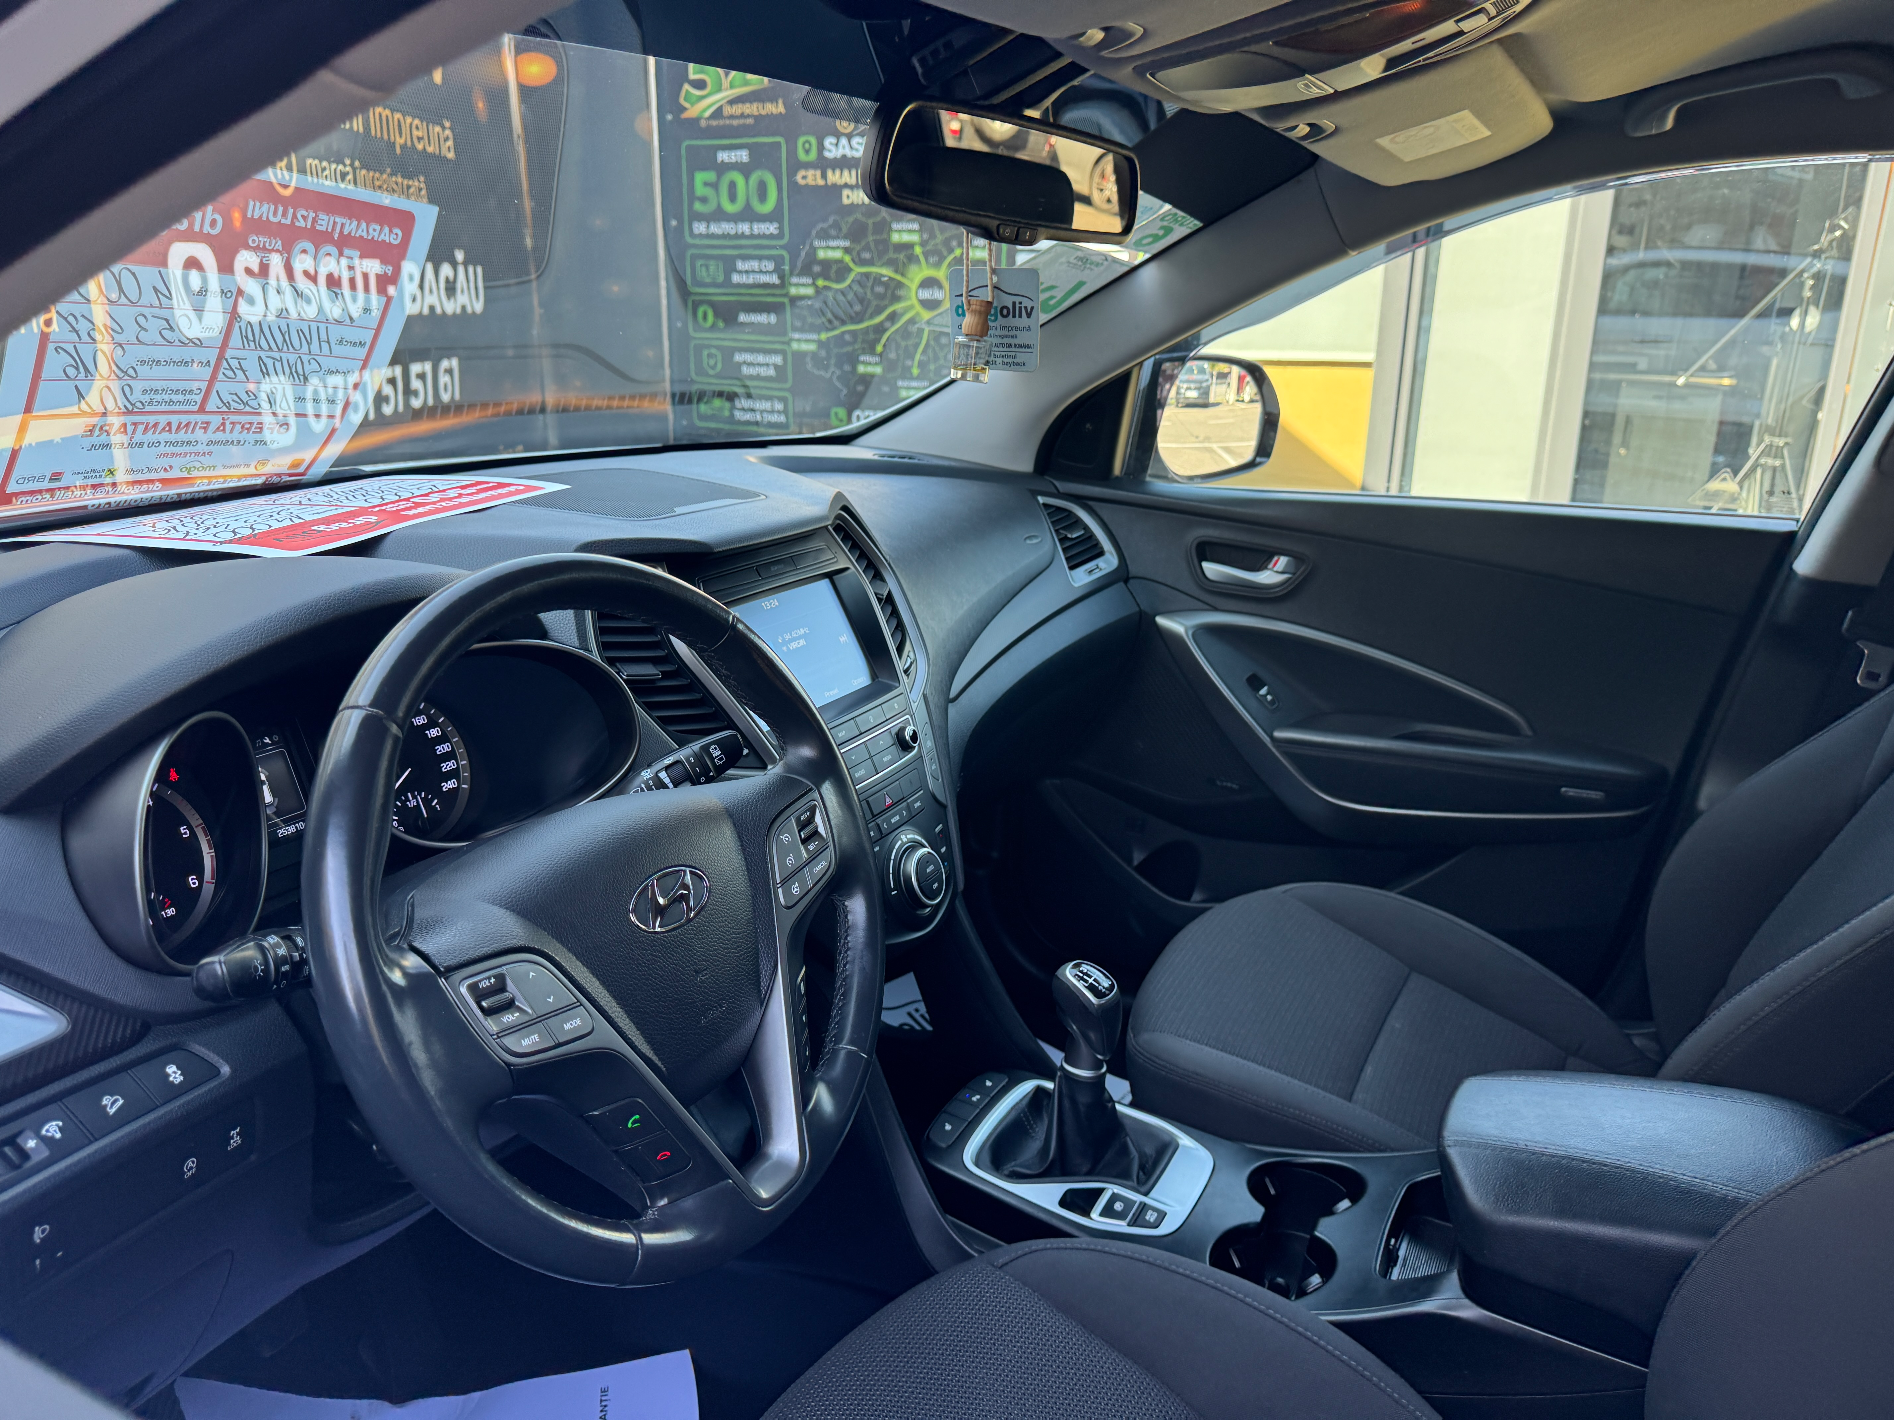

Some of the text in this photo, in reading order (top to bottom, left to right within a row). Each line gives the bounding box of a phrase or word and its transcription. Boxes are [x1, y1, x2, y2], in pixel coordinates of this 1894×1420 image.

[822, 135, 867, 159] SAS
[716, 148, 750, 164] PESTE
[796, 168, 826, 186] CEL
[827, 168, 857, 186] MAI
[693, 169, 778, 214] 500
[234, 251, 382, 322] SASCUT
[401, 249, 485, 316] BACĂU
[955, 300, 1034, 322] dgoliv
[380, 364, 404, 417] 51
[408, 360, 434, 409] 51
[438, 356, 461, 403] 61
[762, 599, 779, 610] 13:24
[412, 715, 428, 726] 160
[425, 727, 441, 738] 180
[435, 742, 452, 754] 200
[440, 760, 457, 772] 220
[441, 779, 458, 791] 240
[179, 826, 190, 838] 5
[277, 822, 305, 838] 253810
[813, 860, 827, 873] CANCEL
[188, 876, 199, 888] 6
[161, 907, 176, 919] 130
[478, 977, 495, 989] VOL+
[563, 1017, 582, 1030] MODE
[521, 1033, 540, 1046] MUTE
[184, 1168, 196, 1178] OFF
